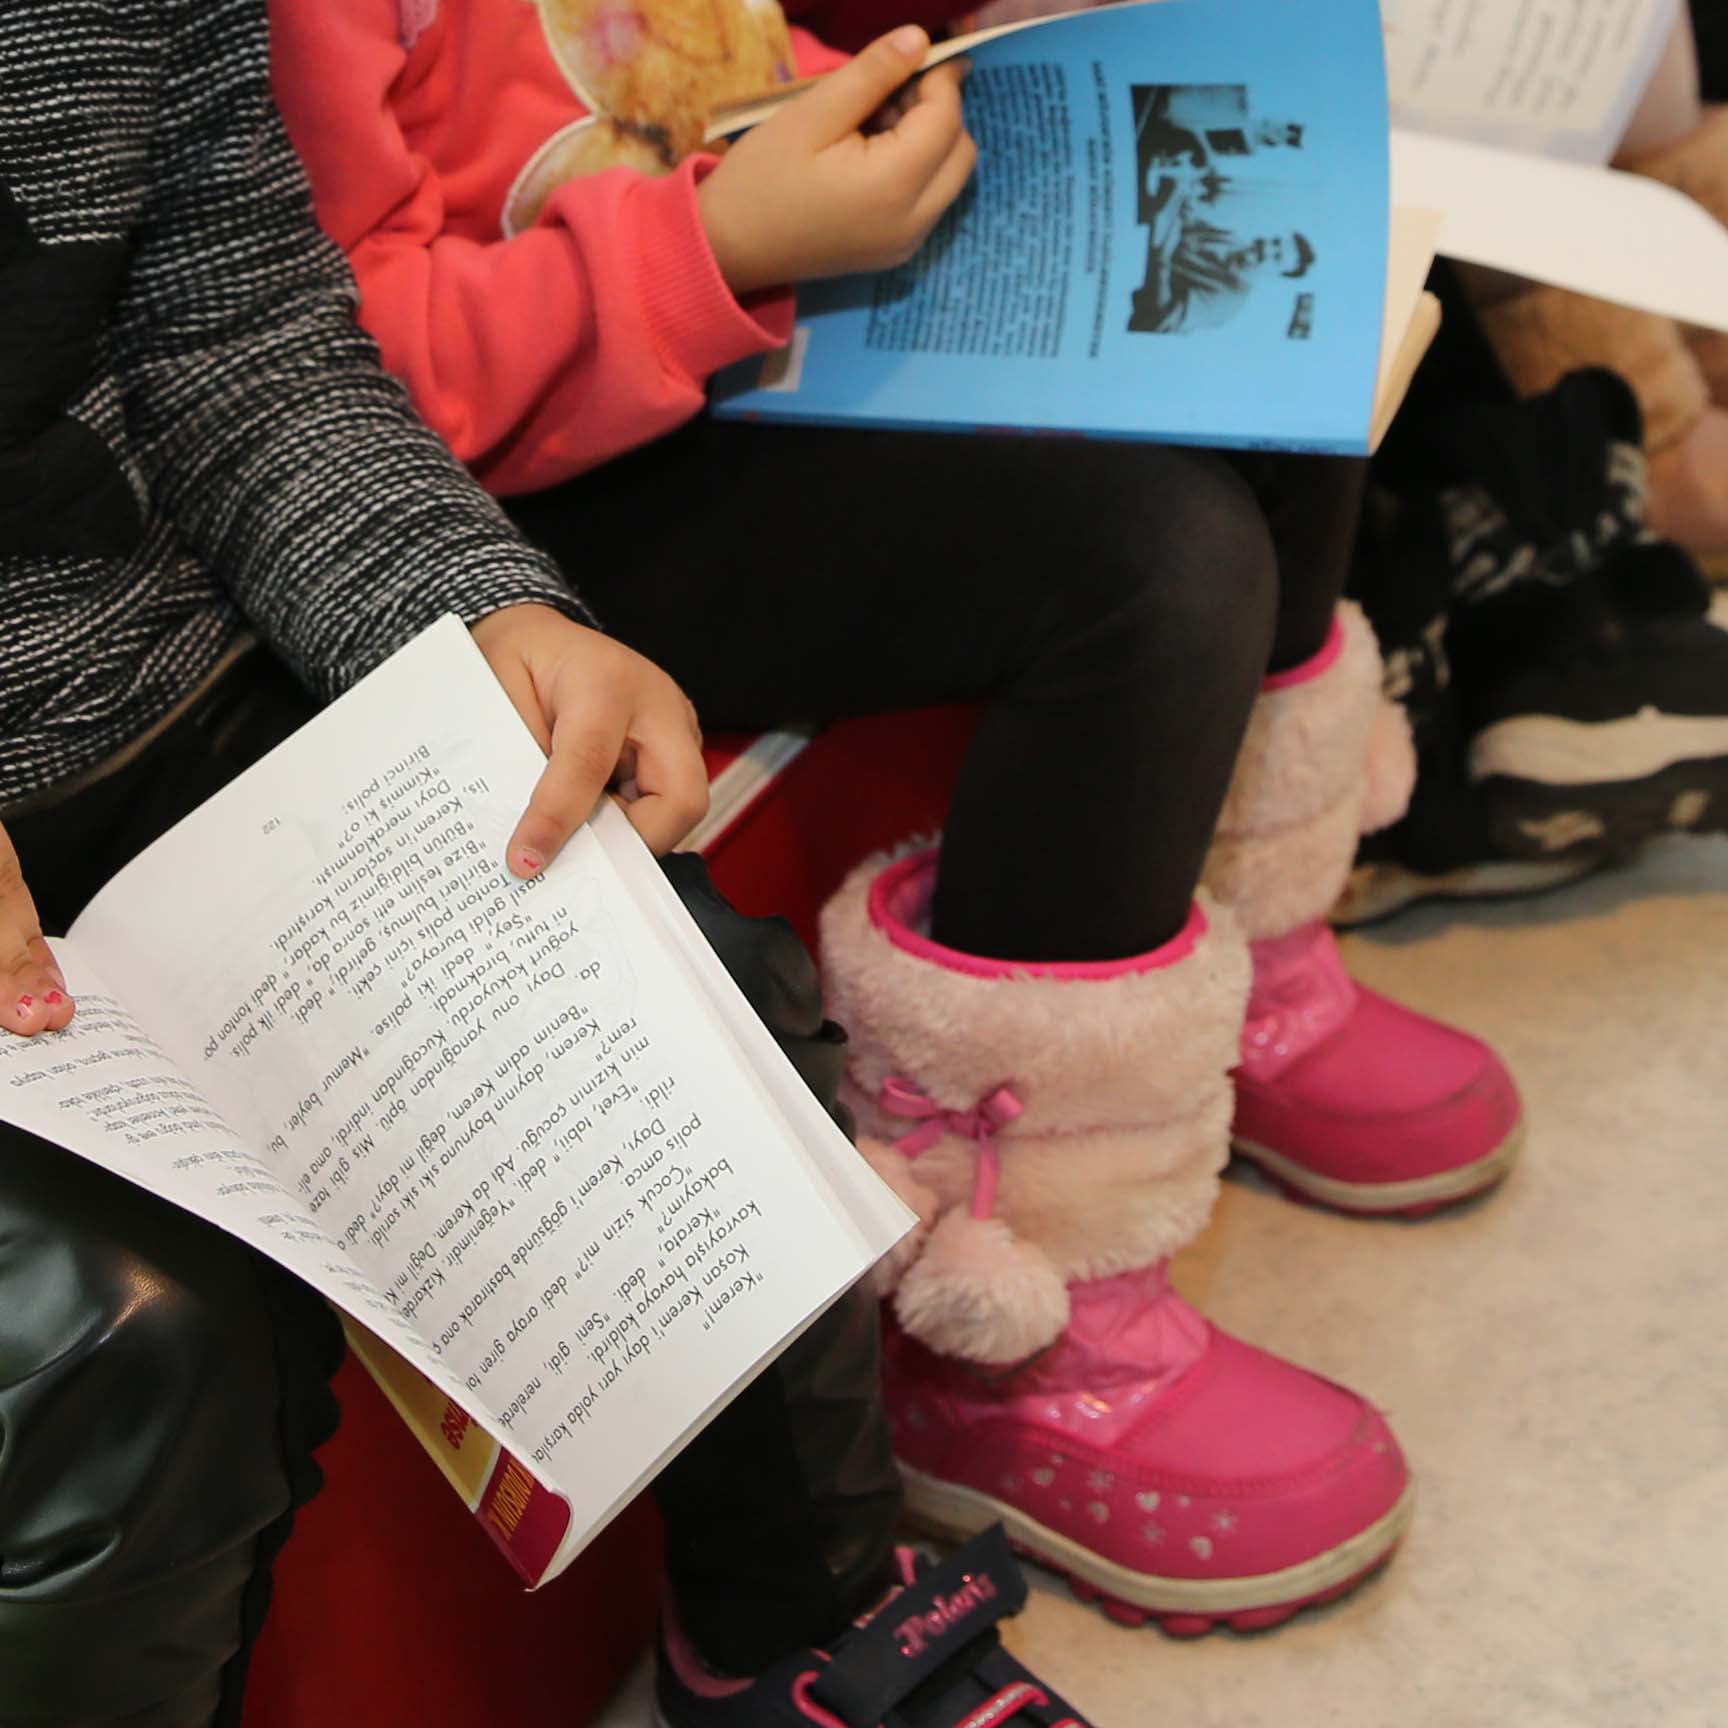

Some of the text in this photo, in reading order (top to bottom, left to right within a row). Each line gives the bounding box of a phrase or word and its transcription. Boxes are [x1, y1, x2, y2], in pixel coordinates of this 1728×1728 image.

[341, 743, 431, 815] Birinci polis:
[336, 765, 441, 849] "Kimmiş ki o?"
[310, 777, 452, 886] Dayı meraklanmıştı.
[420, 819, 475, 855] "Bütün
[268, 776, 490, 953] lis, Kerem'in saçlarını karıştırdı.
[441, 838, 487, 867] "Bize
[347, 851, 425, 913] bildiğimiz
[396, 863, 443, 900] teslim
[437, 857, 499, 903] "Birileri
[328, 908, 353, 929] bu
[371, 896, 396, 924] etti
[377, 894, 441, 938] bulmuş,
[467, 895, 507, 935] geldi
[330, 916, 371, 955] sonra
[346, 872, 512, 1000] Tonton polis içini çekti.
[483, 911, 533, 951] "Şey,"
[527, 918, 580, 967] yoğurt
[281, 926, 332, 980] kadar,"
[304, 951, 331, 987] da,"
[399, 927, 469, 989] buraya?"
[427, 906, 568, 1015] ni tuttu, bırakmadı.
[439, 946, 475, 980] dedi
[573, 960, 601, 981] da.
[249, 972, 279, 1008] dedi
[415, 975, 439, 1000] iki
[445, 961, 530, 1027] kokuyordu.
[525, 960, 566, 993] Dayı
[271, 980, 302, 1016] dedi
[289, 989, 323, 1025] dedi.
[369, 990, 413, 1036] polise.
[490, 993, 520, 1022] onu
[215, 1000, 253, 1041] tonton
[255, 1008, 276, 1032] ilk
[531, 1003, 589, 1045] "Benim
[544, 1016, 602, 1060] Kerem,
[593, 1016, 638, 1063] rem?"
[321, 1044, 370, 1093] "Memur
[369, 1027, 449, 1103] Kucağından
[408, 1015, 487, 1097] yanağından
[493, 1043, 531, 1079] adım
[618, 1035, 651, 1063] min
[445, 1076, 497, 1121] Kerem,
[492, 1062, 544, 1112] dayının
[567, 1060, 623, 1107] kızının
[590, 1082, 640, 1116] "Evet,
[638, 1075, 676, 1110] rildi.
[282, 1090, 324, 1132] beyler,
[329, 1100, 374, 1148] indirdi,
[374, 1097, 409, 1132] öptü.
[514, 1102, 568, 1153] çocuğu.
[350, 1132, 376, 1159] Mis
[414, 1122, 447, 1164] değil
[438, 1108, 498, 1166] boynuna
[551, 1114, 594, 1163] tabii,"
[619, 1110, 702, 1188] polis amca.
[621, 1116, 667, 1152] Dayı,
[308, 1145, 332, 1175] ama
[328, 1155, 351, 1191] gibi
[397, 1154, 416, 1180] mi
[417, 1162, 440, 1189] sıkı
[489, 1152, 516, 1185] Adı
[511, 1156, 548, 1193] dedi.
[307, 1185, 332, 1214] taze
[368, 1173, 401, 1220] dayı?"
[398, 1185, 420, 1211] sıkı
[470, 1179, 491, 1201] da
[568, 1153, 625, 1210] Kerem'i
[635, 1163, 694, 1213] "Çocuk
[655, 1156, 735, 1235] bakayım?"
[343, 1212, 368, 1246] dedi
[366, 1206, 401, 1249] sarıldı.
[431, 1198, 476, 1240] Kerem.
[440, 1197, 516, 1268] "Yeğenimdir.
[509, 1199, 569, 1266] göğsünde
[601, 1207, 635, 1241] sizin
[656, 1206, 721, 1269] "Kerata,"
[405, 1240, 438, 1281] Değil
[573, 1239, 601, 1280] mi?"
[700, 1242, 751, 1286] Koşan
[392, 1270, 409, 1295] mi
[457, 1262, 517, 1327] bastırarak
[538, 1274, 569, 1311] dedi
[585, 1198, 762, 1366] kavrayışta havaya kaldırdı.
[611, 1266, 647, 1303] dedi.
[701, 1269, 764, 1331] "Kerem!"
[504, 1304, 539, 1343] araya
[573, 1311, 612, 1347] "Seni
[649, 1283, 705, 1341] Kerem'i
[439, 1320, 461, 1347] ona
[620, 1333, 651, 1366] dayı
[478, 1337, 506, 1374] giren
[542, 1339, 571, 1376] gidi,
[596, 1356, 624, 1392] yarı
[565, 1382, 599, 1425] yolda
[893, 1574, 998, 1659] Polaris
